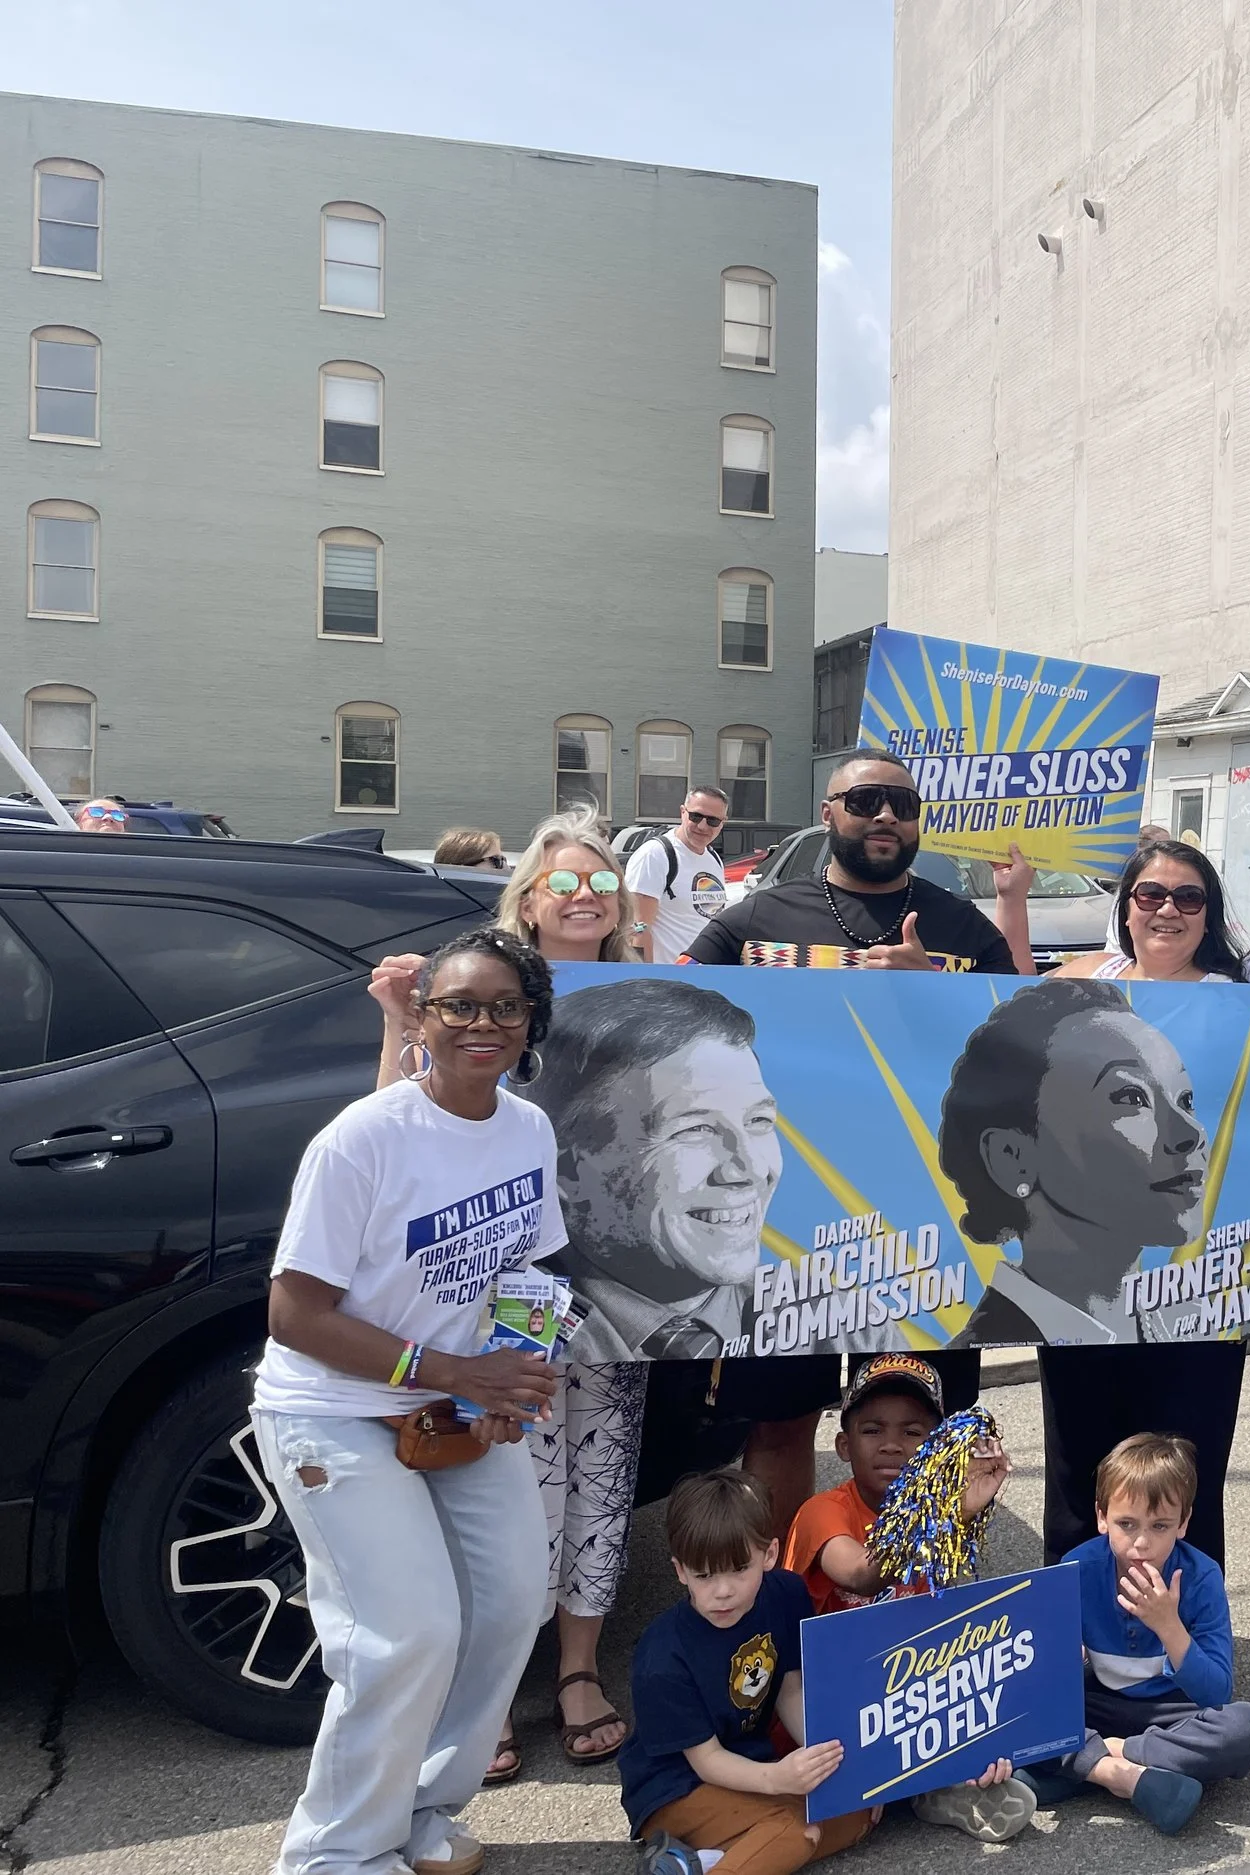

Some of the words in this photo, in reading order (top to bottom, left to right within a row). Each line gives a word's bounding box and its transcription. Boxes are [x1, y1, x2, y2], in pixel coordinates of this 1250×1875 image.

[940, 661, 1089, 702] SheniseForDayton.com
[887, 727, 969, 754] SHENISE
[901, 747, 1131, 802] RNER-SLOSS
[923, 801, 998, 835] MAYOR
[1001, 804, 1022, 827] OF
[1024, 796, 1104, 830] DAYTON
[434, 1207, 461, 1241] I'M
[466, 1194, 492, 1228] ALL
[494, 1184, 510, 1213] IN
[513, 1175, 536, 1205] FOR
[815, 1210, 885, 1250] DARRYL
[418, 1220, 506, 1270] TURNER-SLOSS
[753, 1223, 941, 1313] FAIRCHILD
[420, 1246, 499, 1294] FAIRCHILD
[436, 1288, 457, 1305] FOR
[720, 1334, 751, 1359] FOR
[753, 1261, 967, 1358] COMMISSION
[1173, 1313, 1199, 1338] FOR
[869, 1354, 935, 1384] Guam
[883, 1614, 1012, 1695] Dayton
[859, 1629, 1035, 1749] DESERVES
[893, 1718, 943, 1772] TO
[947, 1683, 1005, 1748] FLY
